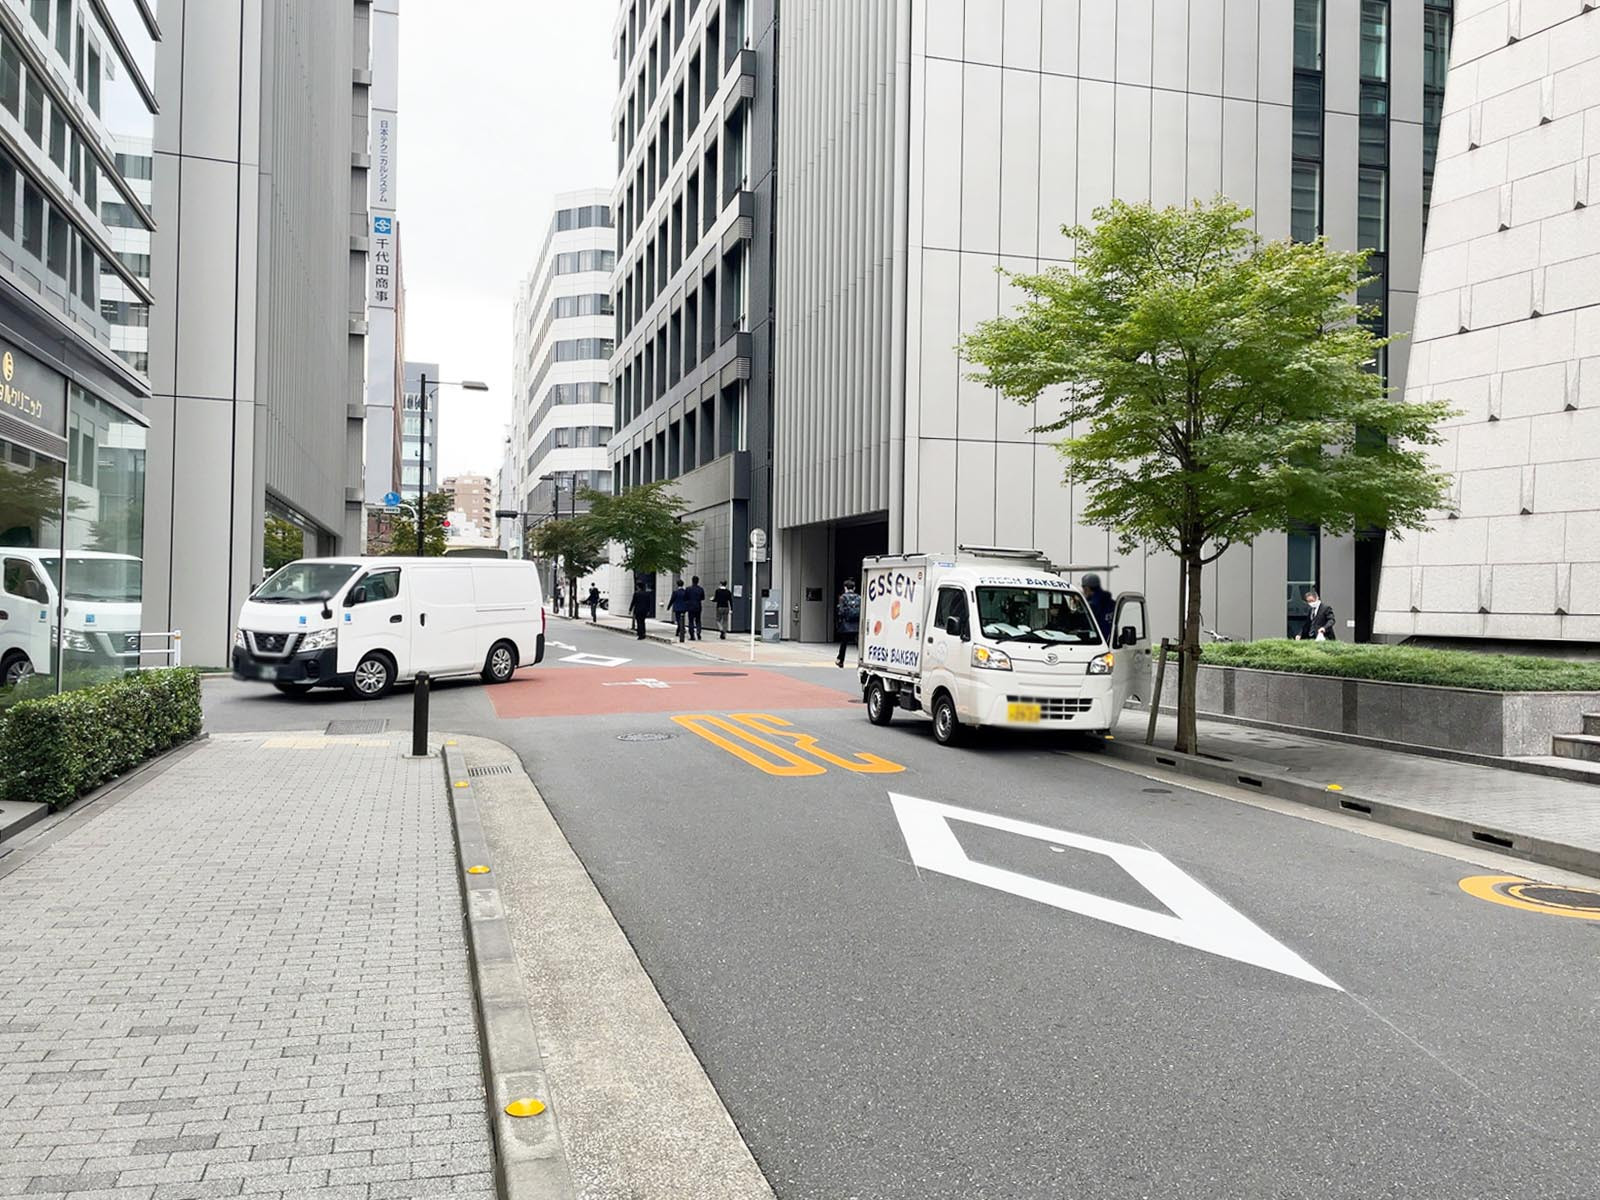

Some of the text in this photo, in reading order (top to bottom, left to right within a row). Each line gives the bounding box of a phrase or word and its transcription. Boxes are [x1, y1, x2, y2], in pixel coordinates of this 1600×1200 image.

[375, 238, 390, 302] 千代田商事
[869, 572, 916, 602] ESSEN
[1025, 577, 1073, 590] BAKERY
[890, 648, 920, 667] BAKERY
